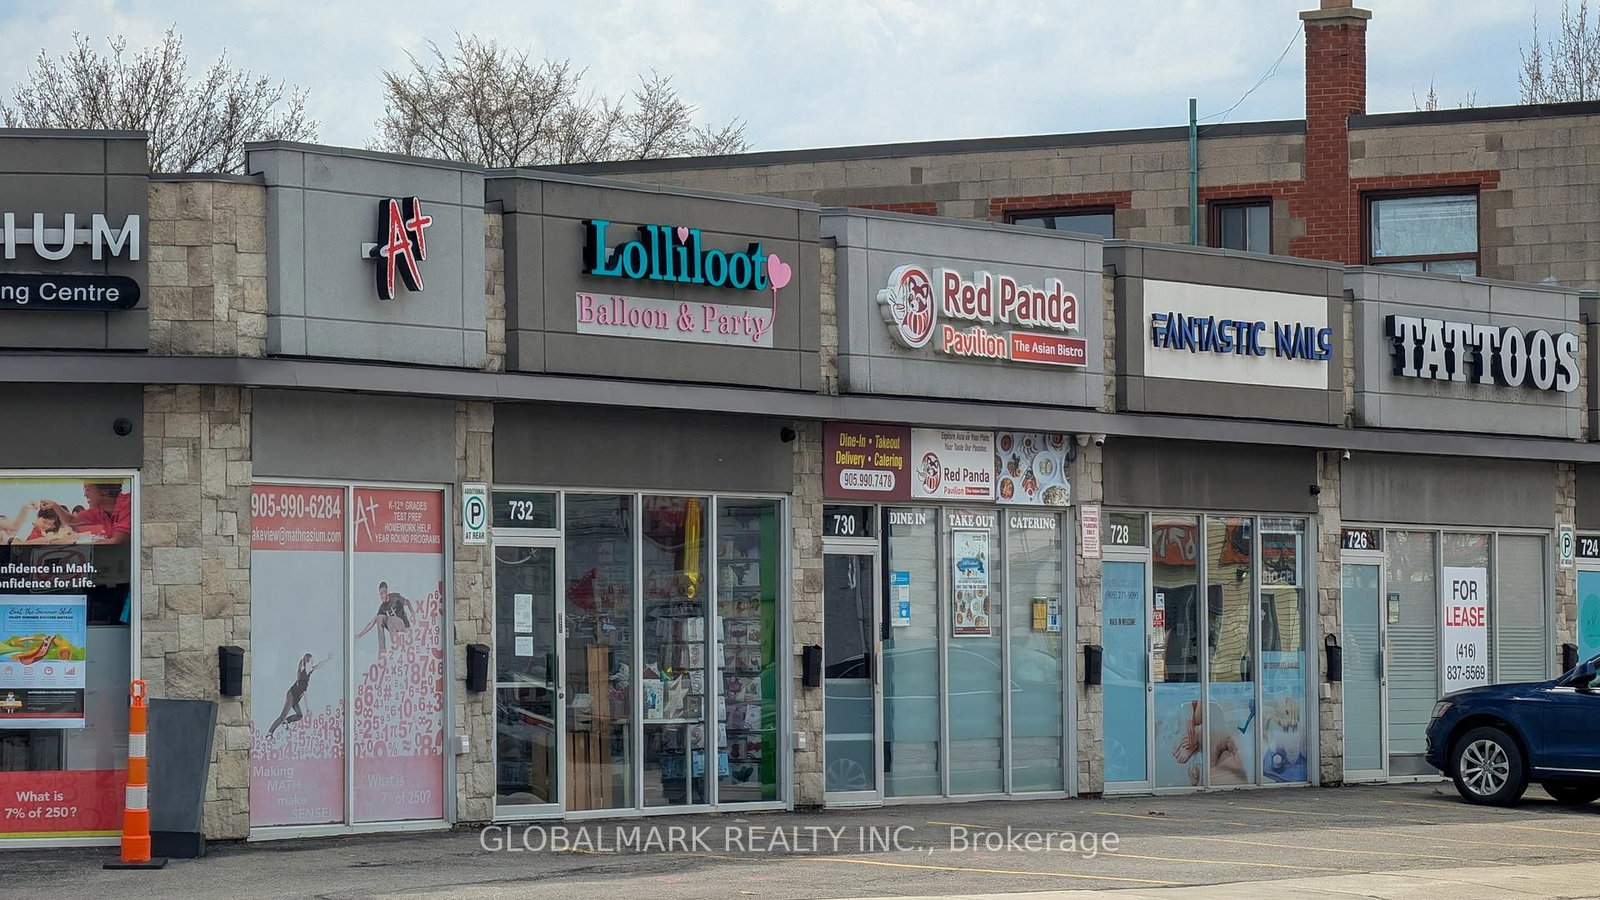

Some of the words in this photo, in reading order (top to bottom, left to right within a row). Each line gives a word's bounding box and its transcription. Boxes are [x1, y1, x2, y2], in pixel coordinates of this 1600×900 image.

[4, 212, 140, 261] IUM
[379, 196, 433, 300] A+
[584, 219, 768, 291] Lolliloot
[1, 285, 29, 304] ng
[39, 282, 120, 302] Centre
[942, 268, 994, 325] Red
[1000, 275, 1078, 331] Panda
[579, 294, 669, 329] Balloon
[677, 303, 695, 331] &
[703, 304, 764, 342] Party
[942, 325, 1007, 359] Pavilion
[1152, 312, 1265, 357] FANTASTIC
[1274, 321, 1333, 360] NAILS
[1014, 340, 1030, 353] The
[1031, 342, 1056, 355] Asian
[1057, 345, 1084, 358] Bistro
[1388, 315, 1581, 393] TATTOOS
[840, 433, 866, 448] Dine-In
[875, 435, 901, 449] Takeout
[836, 451, 865, 468] Delivery
[874, 453, 903, 470] Catering
[844, 473, 892, 488] 905.990.7478
[944, 467, 960, 482] Red
[963, 468, 990, 483] Panda
[251, 493, 341, 519] 905-990-6284
[405, 501, 428, 511] GRADES
[471, 502, 481, 525] P
[509, 500, 534, 520] 732
[394, 512, 407, 521] TEST
[408, 512, 422, 521] PREP
[833, 514, 855, 535] 730
[889, 512, 914, 525] DINE
[915, 513, 926, 525] IN
[949, 515, 974, 527] TAKE
[977, 516, 995, 528] OUT
[1010, 517, 1056, 530] CATERING
[384, 523, 416, 533] HOMEWORK
[417, 523, 431, 533] HELP
[472, 532, 485, 540] REAR
[1110, 525, 1129, 544] 728
[375, 533, 389, 543] YEAR
[390, 533, 409, 543] ROUND
[410, 534, 440, 544] PROGRAMS
[1347, 531, 1367, 549] 726
[1581, 539, 1599, 556] 724
[52, 563, 63, 574] in
[66, 563, 97, 574] Math.
[54, 578, 70, 588] for
[72, 578, 96, 588] Life.
[1452, 580, 1478, 600] FOR
[1446, 607, 1485, 627] LEASE
[1456, 643, 1476, 661] (416)
[1447, 665, 1485, 680] 837-5569
[253, 766, 294, 778] Making
[367, 773, 394, 787] What
[267, 779, 301, 792] MATH
[16, 791, 50, 802] What
[54, 791, 64, 801] is
[408, 790, 431, 805] 250?
[5, 808, 25, 819] 7%
[28, 807, 43, 818] of
